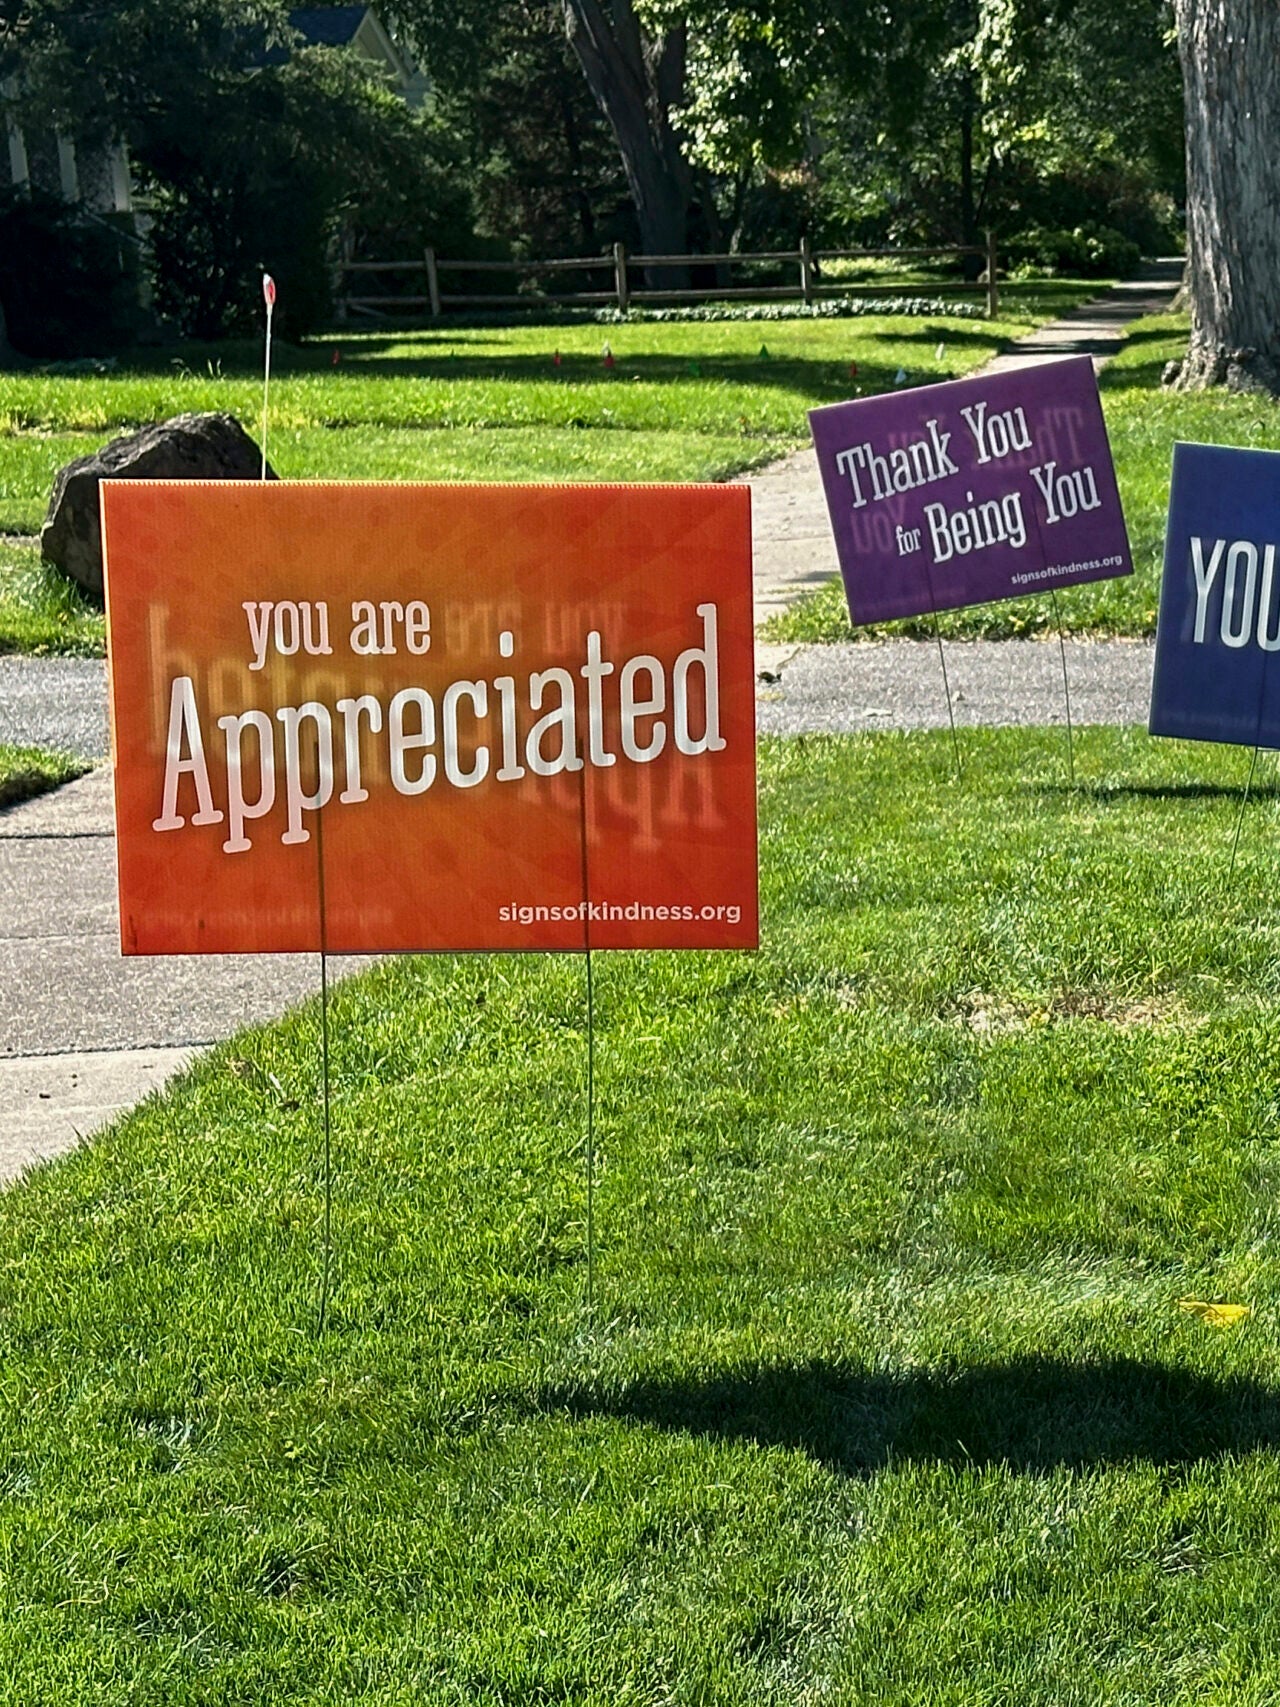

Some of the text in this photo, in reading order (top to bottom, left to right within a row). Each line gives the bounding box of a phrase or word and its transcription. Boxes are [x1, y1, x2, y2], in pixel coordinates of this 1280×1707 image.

[835, 419, 960, 509] Thank
[960, 401, 1033, 465] You
[894, 461, 1102, 564] for Being You
[1010, 554, 1123, 585] signsofkindness.org
[241, 600, 431, 671] you are
[152, 602, 727, 854] Appreciated
[498, 901, 742, 925] signsofkindness.org
